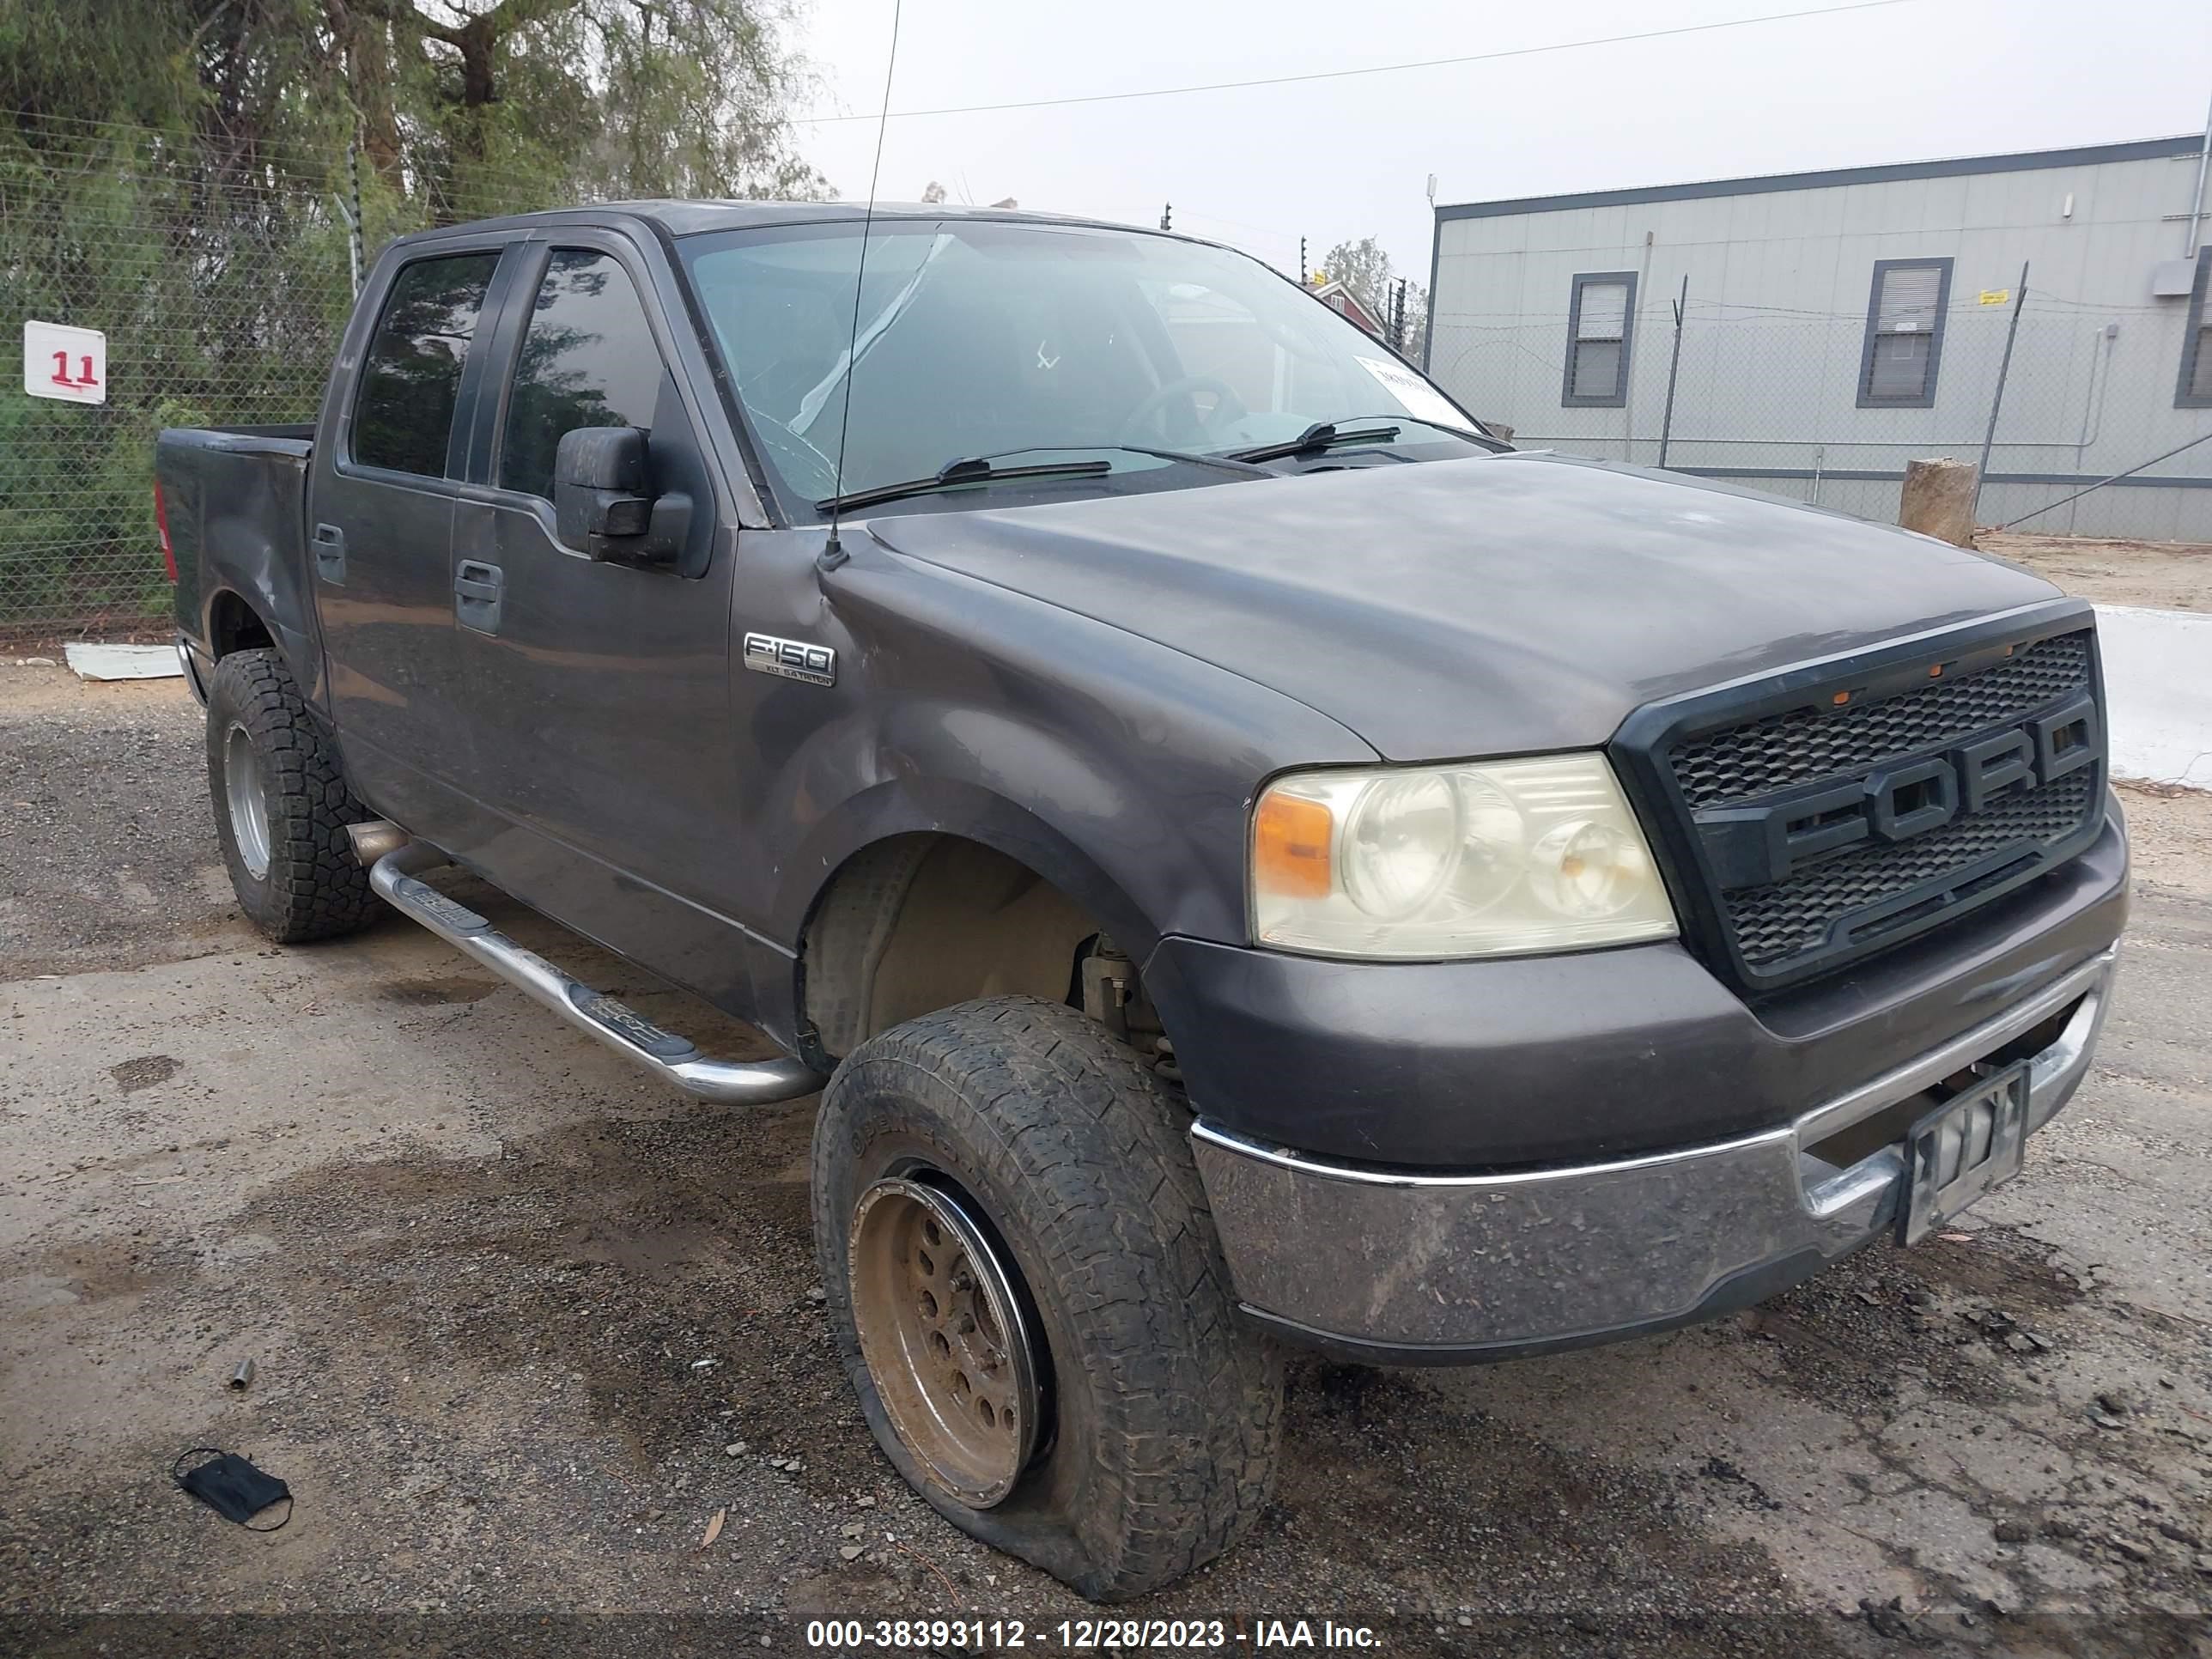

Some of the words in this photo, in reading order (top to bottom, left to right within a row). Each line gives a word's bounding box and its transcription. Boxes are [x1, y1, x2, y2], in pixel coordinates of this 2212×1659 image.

[52, 350, 99, 386] 11
[745, 636, 830, 672] F-150
[765, 665, 781, 674] XLT
[1762, 694, 2101, 883] FORD
